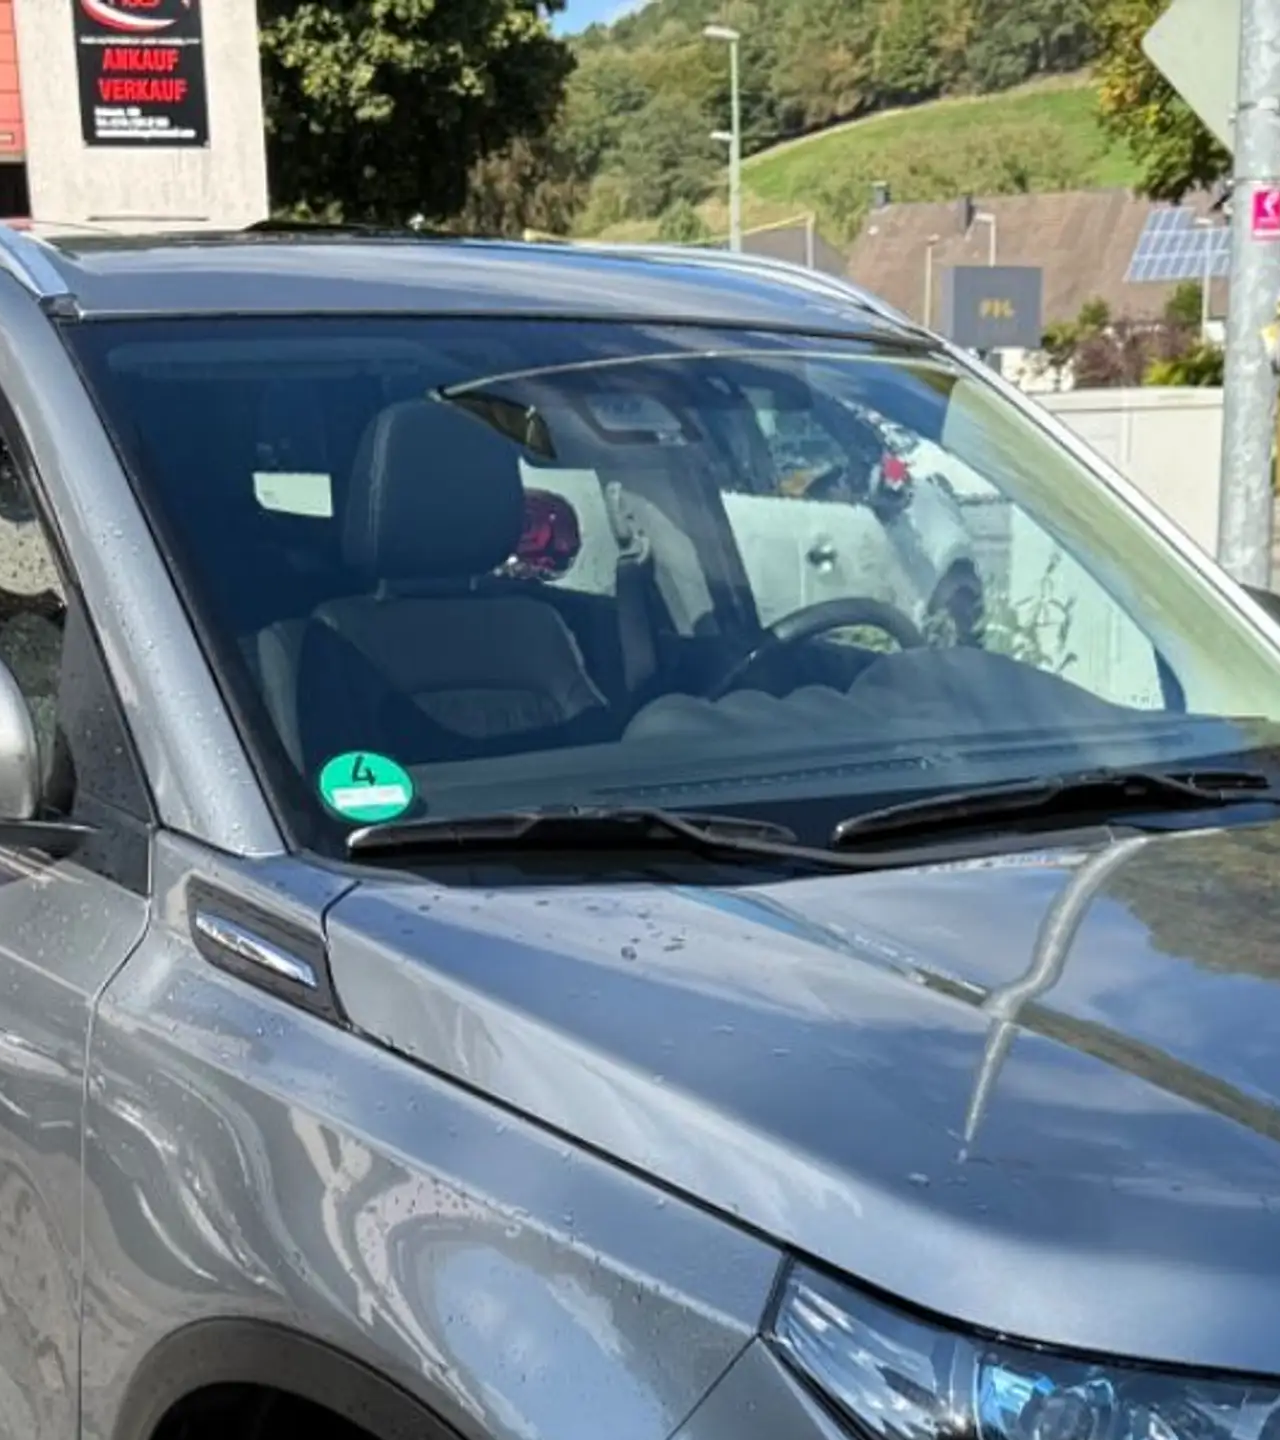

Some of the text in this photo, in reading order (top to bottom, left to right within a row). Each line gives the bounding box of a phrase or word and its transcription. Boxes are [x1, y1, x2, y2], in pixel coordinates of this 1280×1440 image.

[102, 48, 180, 72] ANKAUF
[98, 78, 188, 102] VERKAUF
[351, 755, 376, 786] 4
